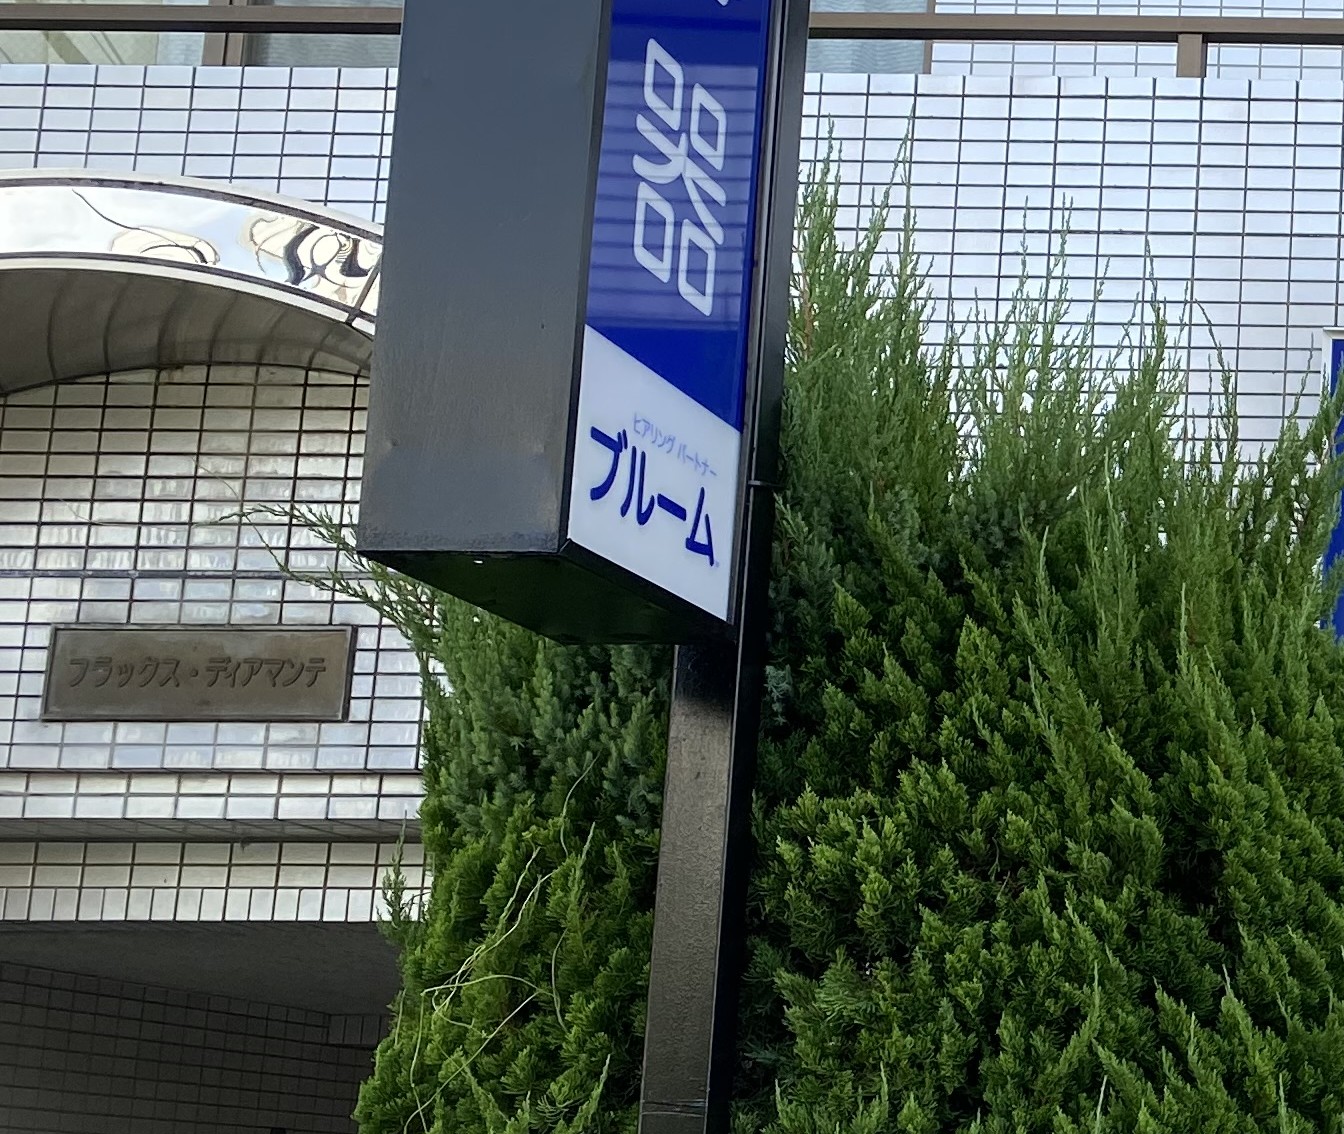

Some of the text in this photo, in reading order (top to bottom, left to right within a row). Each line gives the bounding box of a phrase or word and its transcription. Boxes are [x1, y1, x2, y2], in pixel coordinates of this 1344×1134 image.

[633, 412, 718, 477] ヒアリング パートナー
[590, 426, 716, 567] ブルーム
